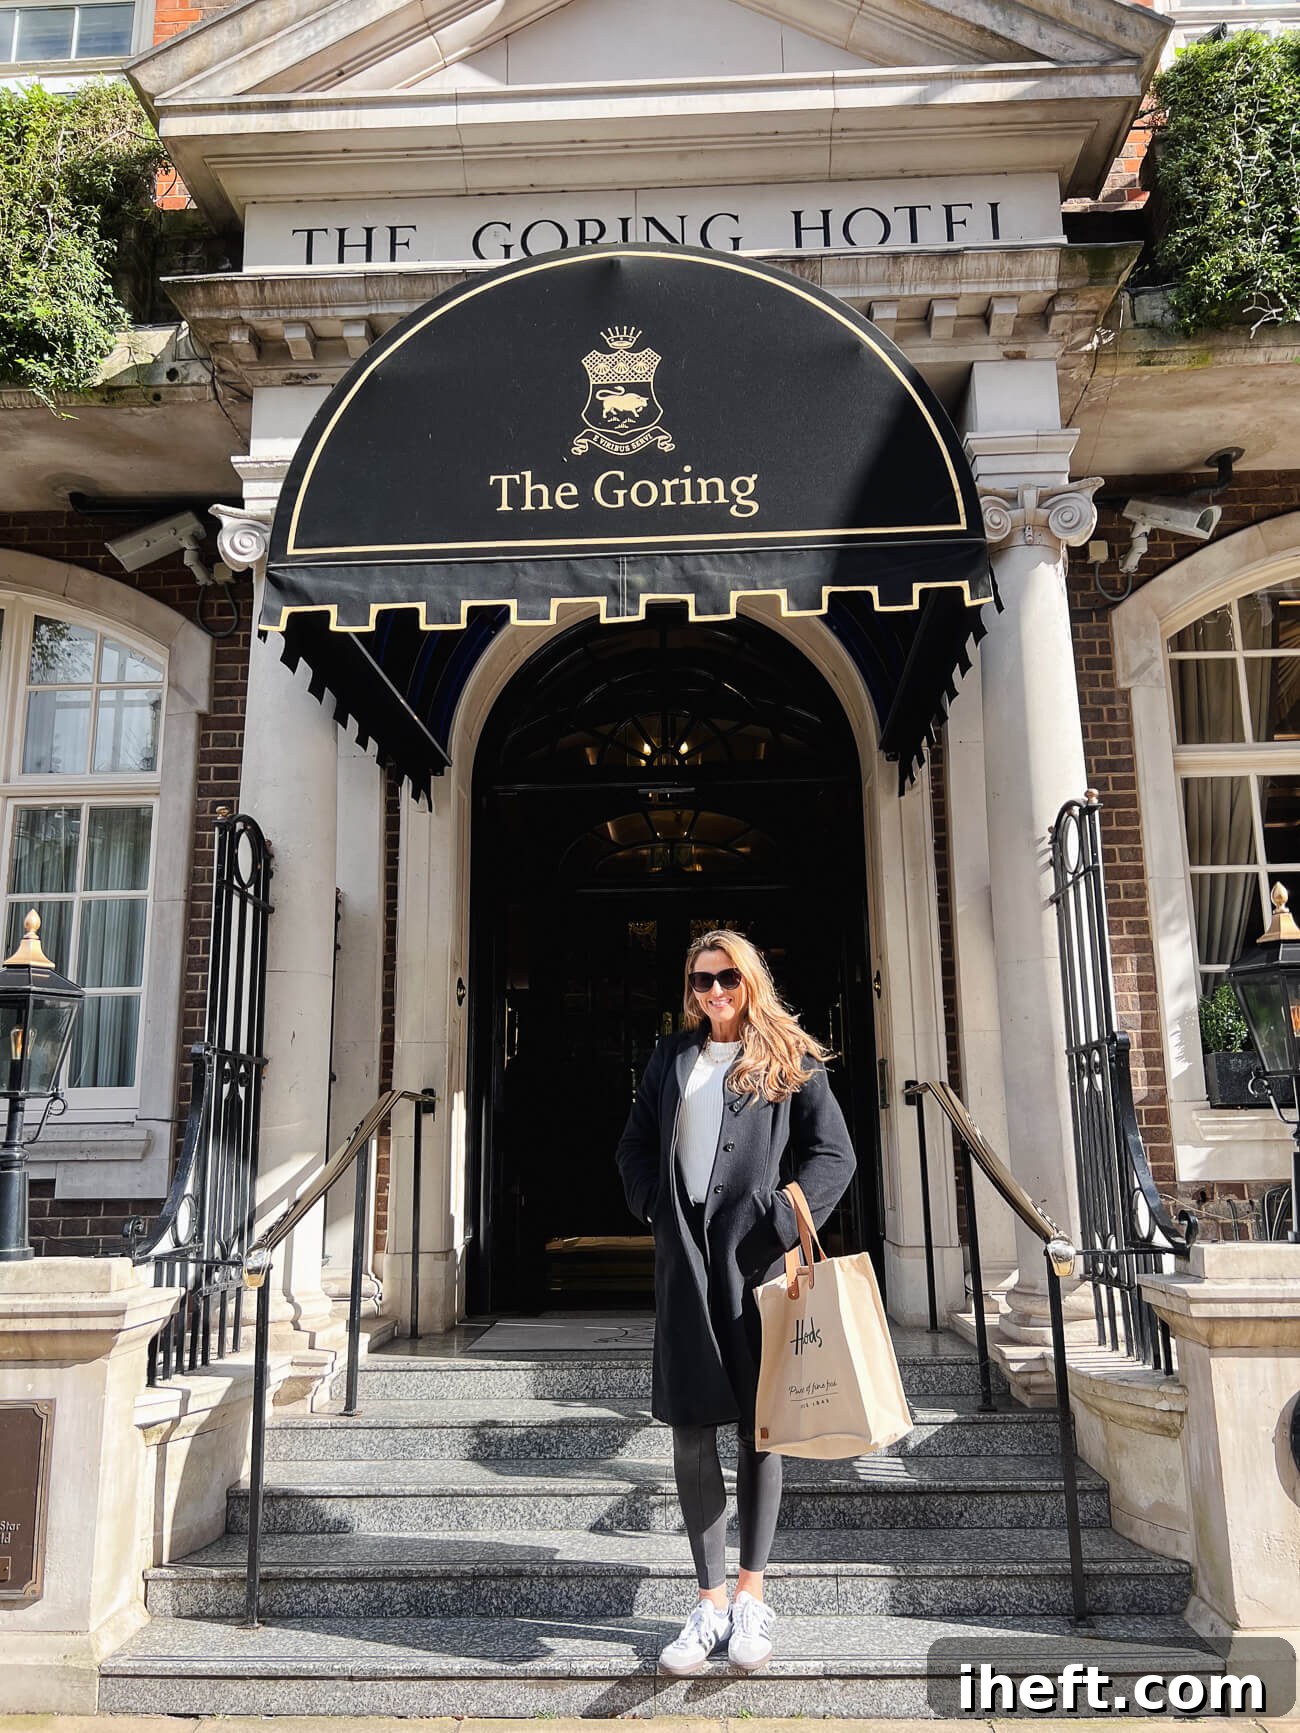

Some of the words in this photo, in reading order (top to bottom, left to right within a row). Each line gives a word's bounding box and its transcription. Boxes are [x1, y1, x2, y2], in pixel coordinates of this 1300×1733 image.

[599, 438, 631, 453] VIRIBUS
[631, 432, 653, 449] SERVI
[489, 471, 580, 512] The
[594, 465, 760, 518] Goring
